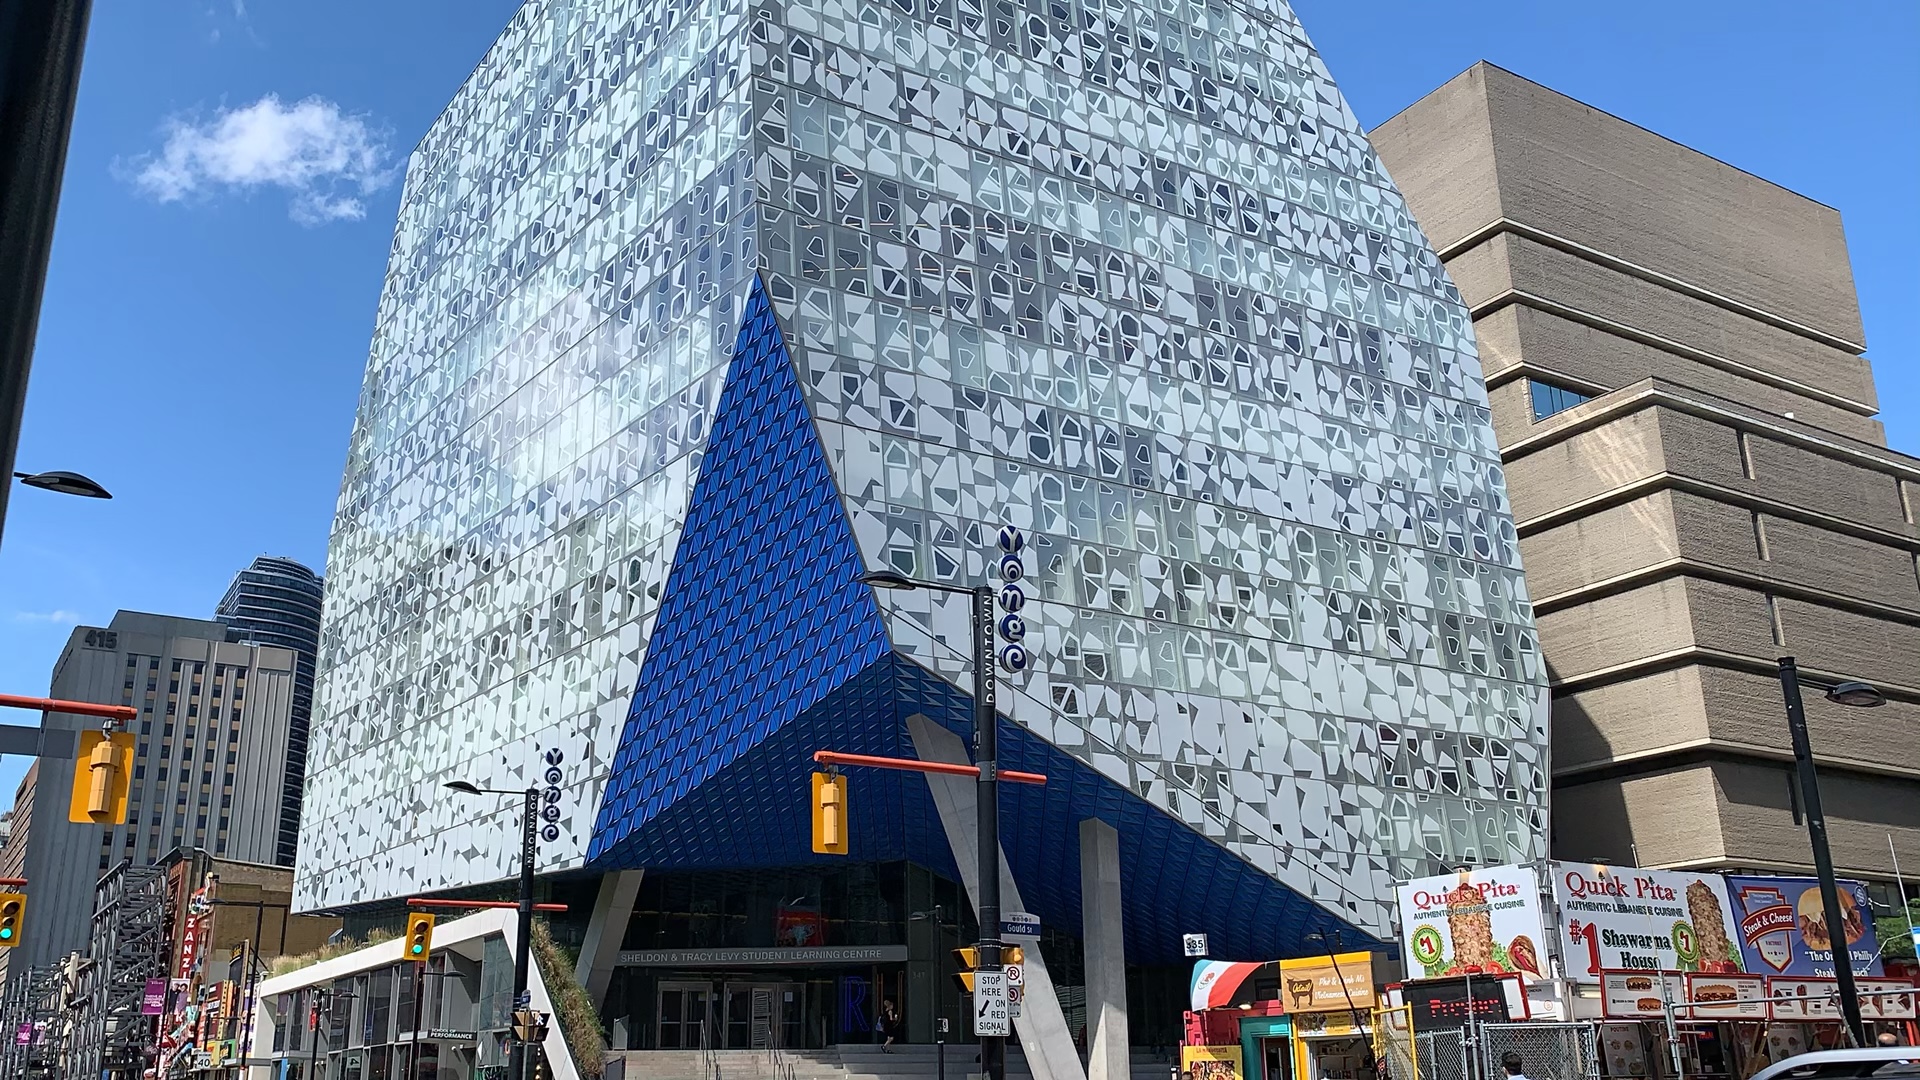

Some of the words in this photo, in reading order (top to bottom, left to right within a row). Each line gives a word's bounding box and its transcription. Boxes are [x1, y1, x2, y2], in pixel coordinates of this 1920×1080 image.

[84, 629, 118, 649] 415
[983, 594, 995, 704] DOWNTOWN
[526, 794, 537, 867] DOWNTOWN
[1565, 871, 1631, 900] Quick
[1634, 877, 1676, 901] Pita
[1413, 885, 1468, 911] Quick
[1477, 881, 1518, 901] Pita
[1494, 899, 1526, 911] CUISINE
[1566, 900, 1612, 913] AUTHENTIC
[1612, 903, 1654, 916] LEBANESE
[1654, 906, 1685, 918] CUISINE
[1007, 923, 1026, 934] Gould
[1743, 917, 1763, 937] Steak
[1762, 914, 1770, 926] &
[1769, 912, 1793, 924] Cheese
[1569, 918, 1600, 977] #1
[620, 953, 668, 963] SHELDON
[671, 953, 678, 962] &
[681, 952, 713, 962] TRACY
[715, 952, 740, 961] LEVY
[742, 951, 788, 961] STUDENT
[790, 950, 841, 960] LEARNING
[842, 949, 882, 959] CENTRE
[1814, 967, 1837, 978] Steak
[981, 976, 1001, 985] STOP
[1331, 977, 1337, 986] &
[981, 987, 1002, 997] HERE
[995, 999, 1006, 1008] ON
[991, 1010, 1006, 1020] RED
[979, 1021, 1006, 1031] SIGNAL
[430, 1032, 473, 1040] PERFORMANCE
[198, 1058, 211, 1067] 40
